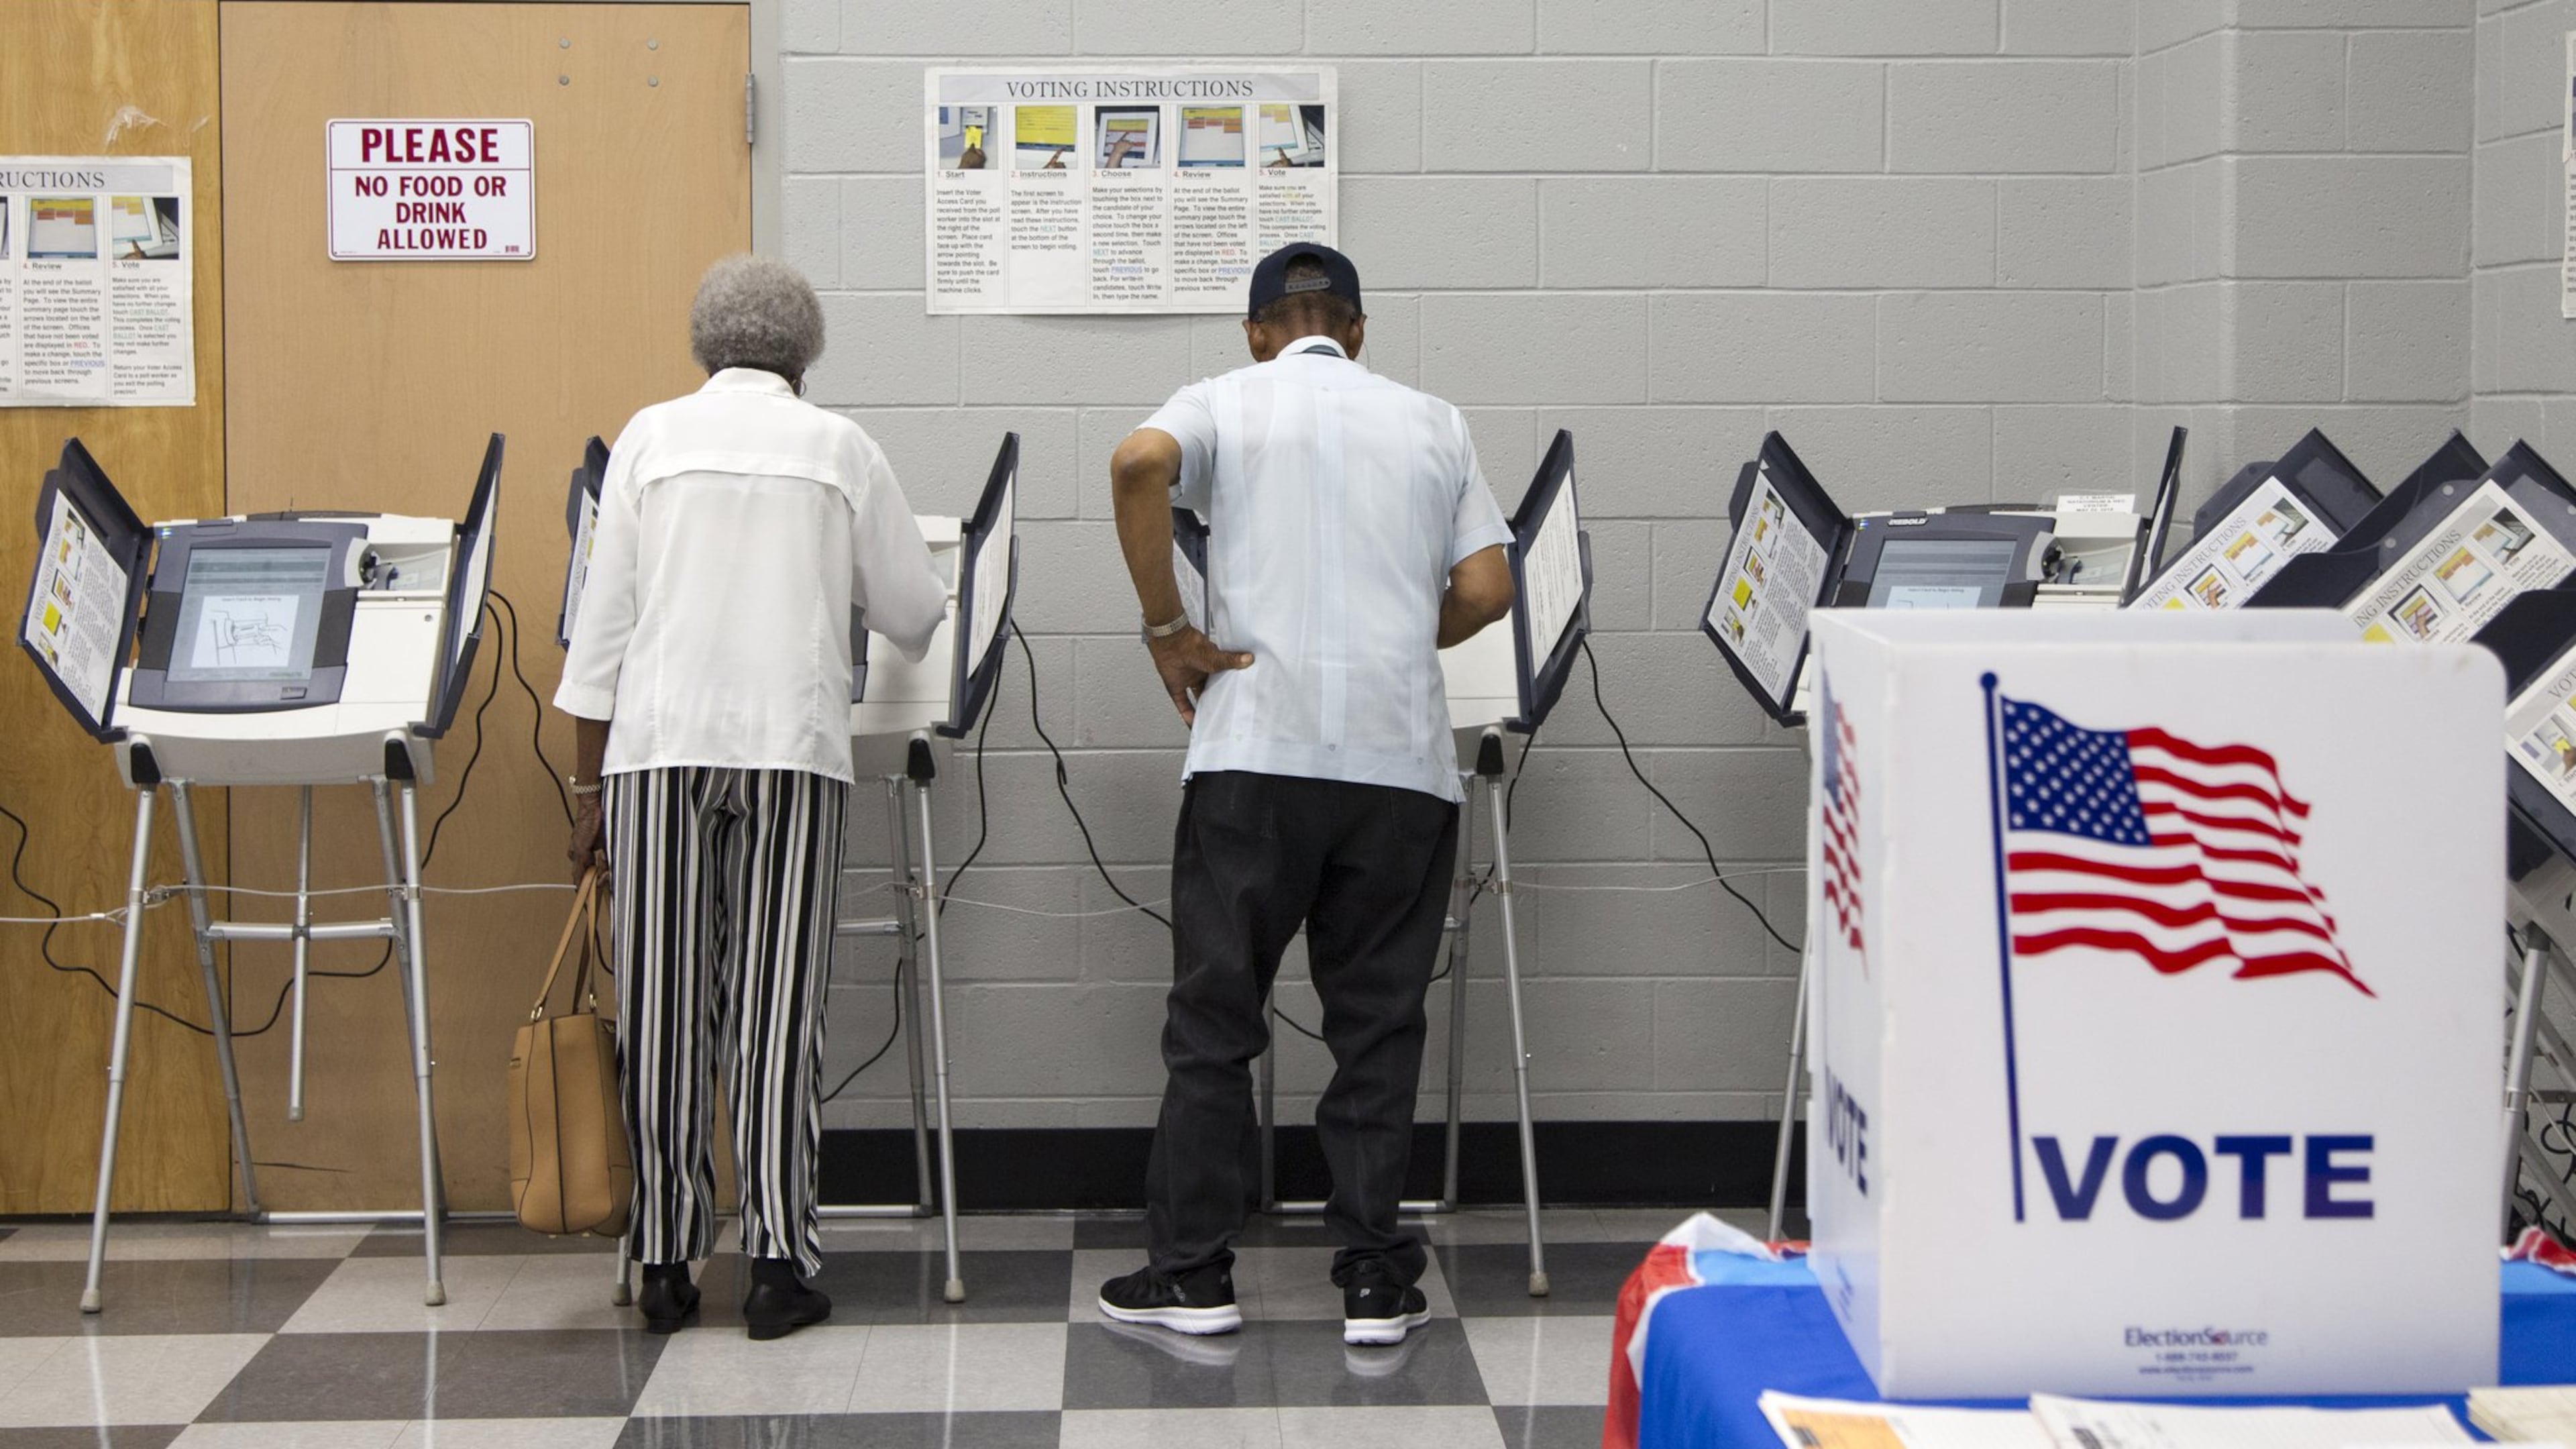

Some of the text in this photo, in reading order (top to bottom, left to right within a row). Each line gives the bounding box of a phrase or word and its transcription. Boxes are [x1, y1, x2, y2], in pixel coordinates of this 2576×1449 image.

[1006, 80, 1254, 97] VOTING INSTRUCTIONS
[362, 128, 499, 163] PLEASE
[355, 176, 506, 197] NO FOOD OR
[1092, 195, 1118, 203] touching
[1220, 196, 1248, 204] Summary
[396, 202, 466, 223] DRINK
[377, 228, 487, 250] ALLOWED
[121, 260, 140, 269] Vote
[1174, 267, 1197, 275] specific
[1888, 518, 1928, 526] DIEBOLD
[2174, 517, 2247, 584] INSTRUCTIONS
[2375, 529, 2461, 608] INSTRUCTIONS
[1825, 1065, 1868, 1198] VOTE
[2031, 1134, 2374, 1222] VOTE
